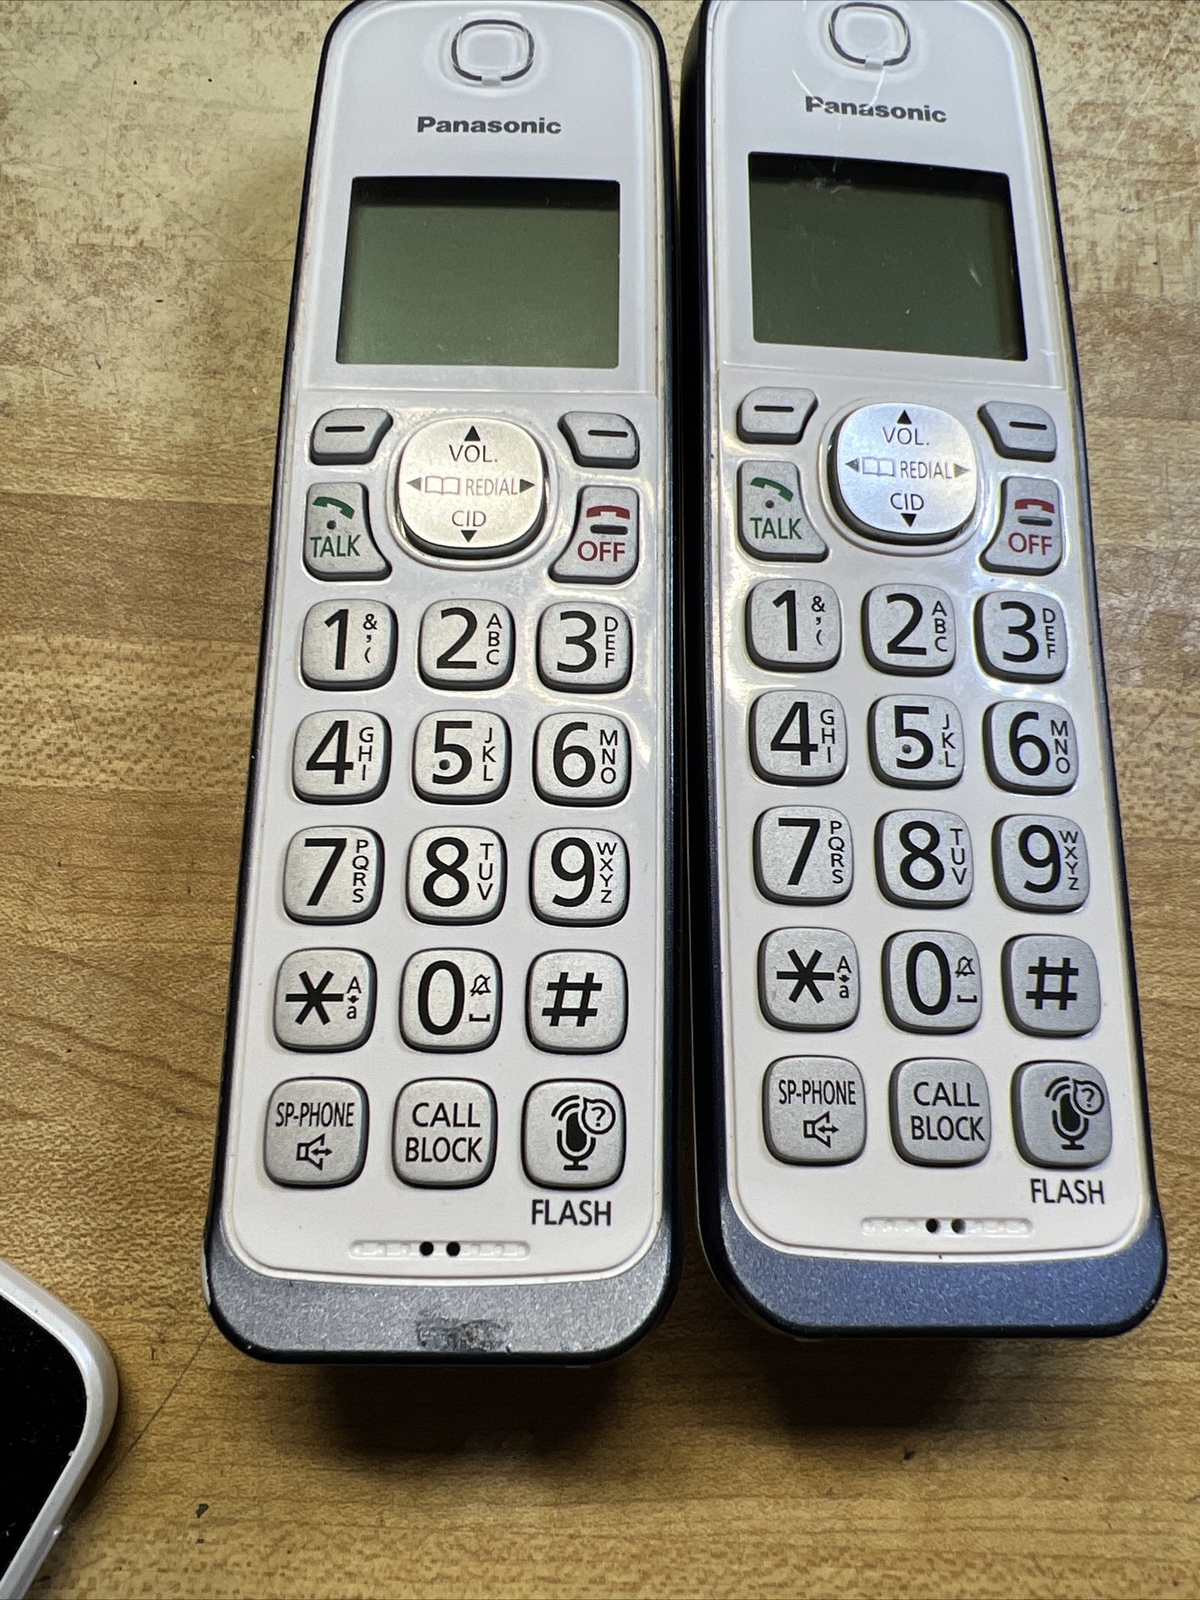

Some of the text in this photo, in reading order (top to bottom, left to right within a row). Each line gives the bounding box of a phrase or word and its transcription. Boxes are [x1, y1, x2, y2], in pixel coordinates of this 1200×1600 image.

[417, 116, 562, 135] Panasonic
[805, 95, 947, 123] Panasonic
[448, 444, 498, 463] VOL.
[882, 426, 931, 446] VOL.
[465, 477, 519, 496] REDIAL
[900, 460, 952, 480] REDIAL
[451, 510, 487, 527] CID
[889, 492, 925, 511] CID
[309, 534, 361, 559] TALK
[749, 517, 803, 540] TALK
[1008, 532, 1053, 556] OFF
[577, 540, 626, 563] OFF
[323, 608, 350, 671] 1
[436, 606, 478, 670] 2
[772, 589, 798, 652] 1
[885, 592, 928, 656] 2
[999, 600, 1040, 663] 3
[556, 610, 597, 674] 3
[305, 719, 355, 785] 4
[431, 720, 473, 785] 5
[552, 721, 596, 788] 6
[770, 701, 819, 767] 4
[893, 704, 934, 770] 5
[1008, 710, 1051, 777] 6
[303, 837, 348, 907] 7
[422, 836, 470, 908] 8
[550, 836, 596, 908] 9
[777, 817, 821, 886] 7
[898, 820, 945, 891] 8
[1017, 824, 1063, 894] 9
[541, 971, 603, 1028] #
[1025, 956, 1080, 1011] #
[778, 1079, 857, 1106] SP-PHONE
[913, 1081, 981, 1108] CALL
[274, 1101, 355, 1128] SP-PHONE
[411, 1102, 481, 1128] CALL
[910, 1115, 986, 1142] BLOCK
[404, 1136, 483, 1163] BLOCK
[531, 1198, 612, 1227] FLASH
[1030, 1178, 1105, 1205] FLASH
